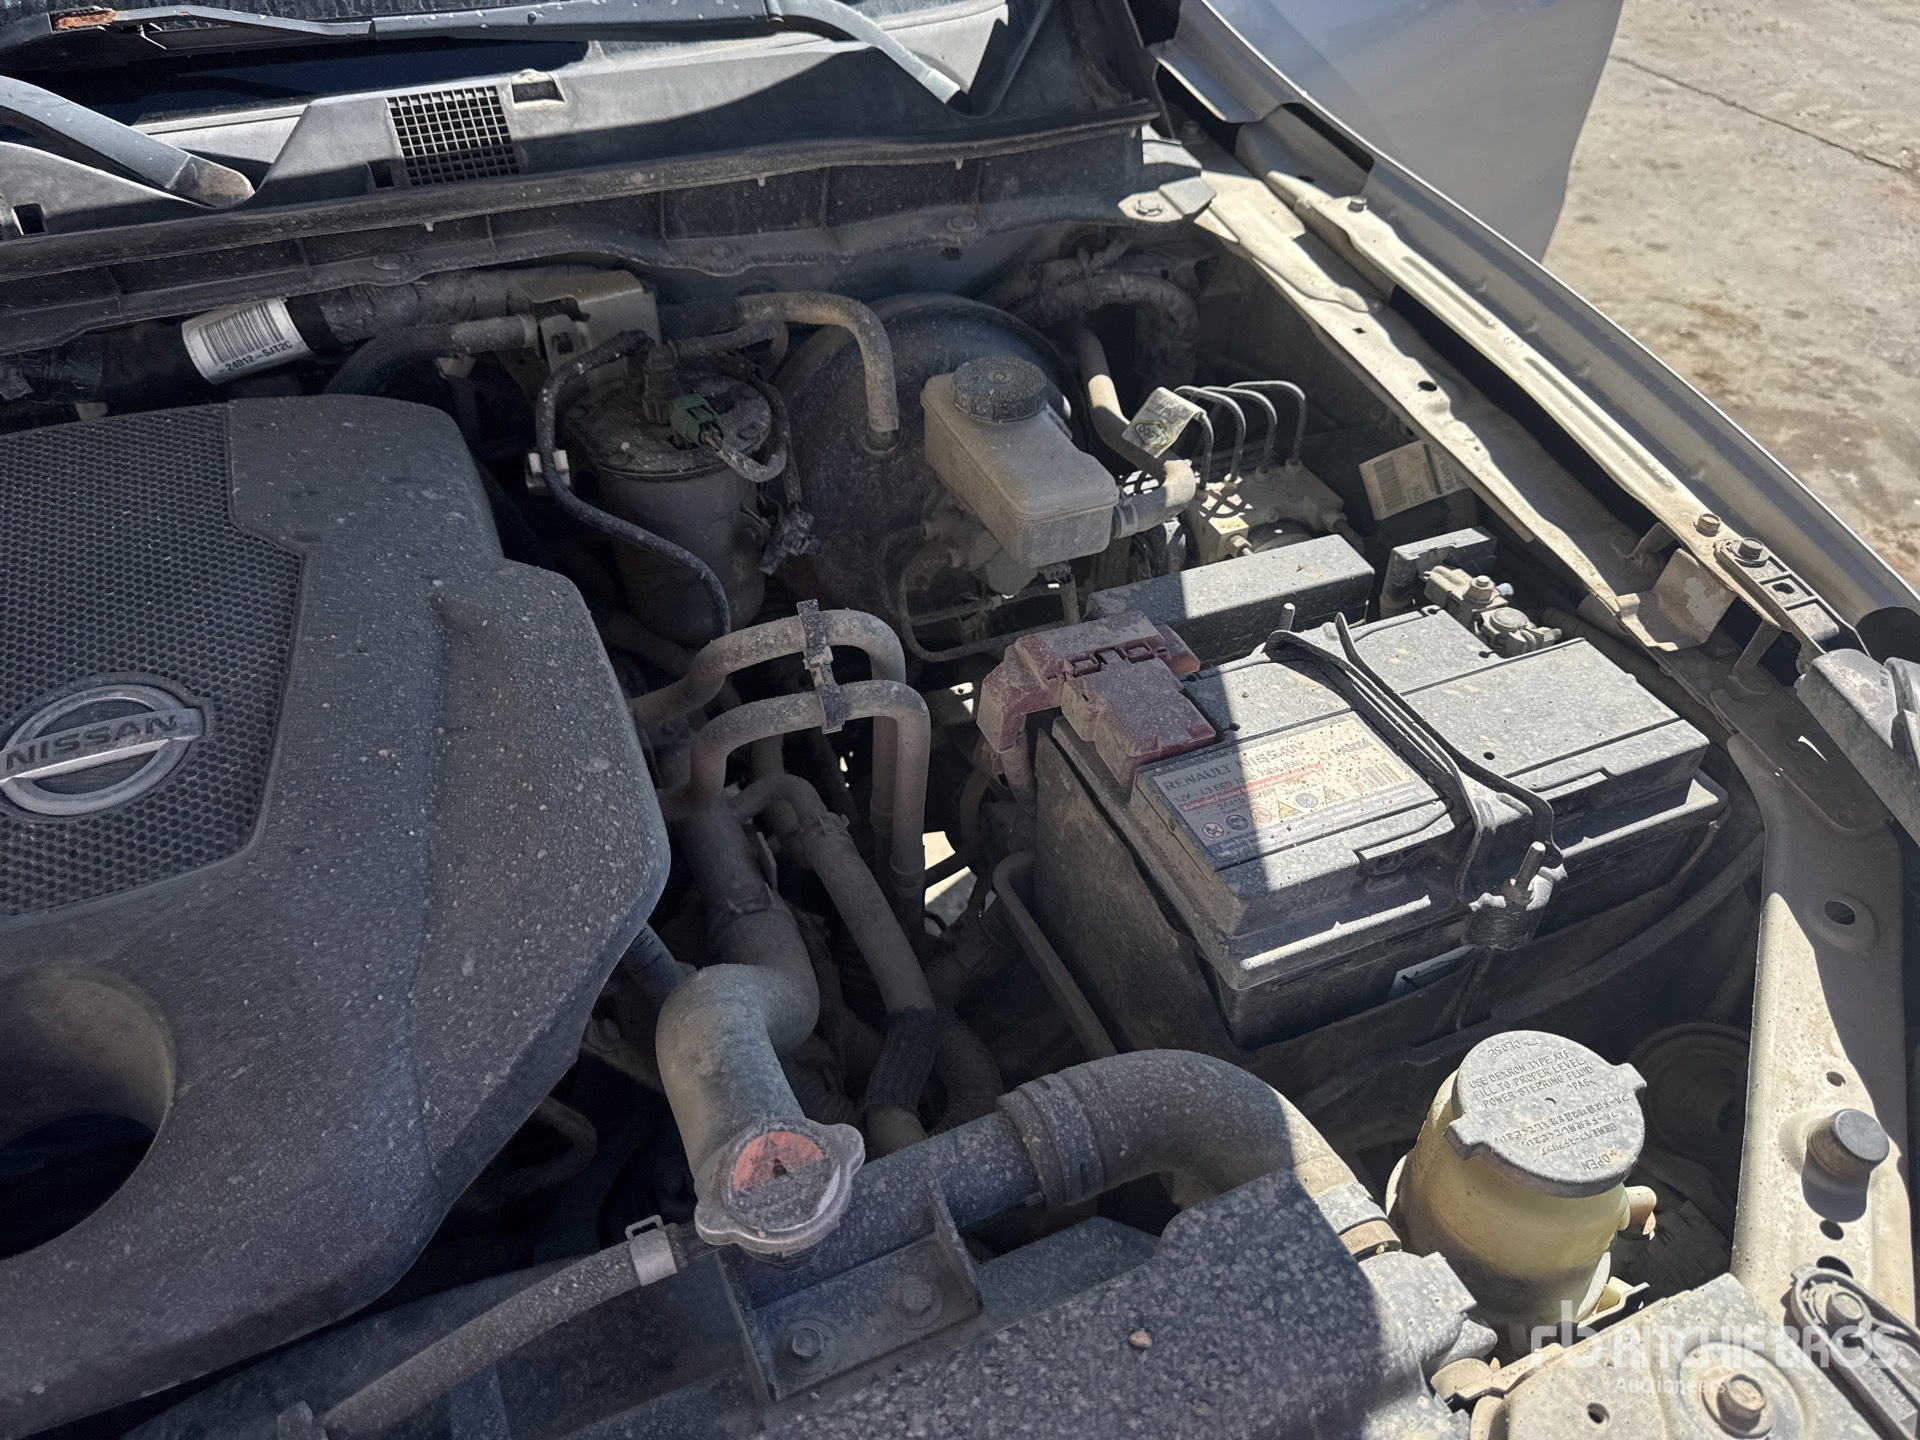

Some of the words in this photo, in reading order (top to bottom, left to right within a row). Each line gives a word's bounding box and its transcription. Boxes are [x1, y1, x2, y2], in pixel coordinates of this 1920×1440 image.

[6, 714, 177, 770] NISSAN
[1162, 763, 1232, 792] RENAULT
[1235, 742, 1306, 770] NISSAN
[1488, 1039, 1521, 1059] CLOSE
[1468, 1078, 1489, 1089] USE
[1488, 1064, 1528, 1083] DEXRON
[1527, 1055, 1553, 1069] TYPE
[1473, 1086, 1498, 1100] FILL
[1497, 1080, 1511, 1091] TO
[1513, 1067, 1551, 1086] PROPER
[1481, 1091, 1517, 1109] POWER
[1517, 1075, 1565, 1097] STEERING
[1565, 1066, 1594, 1081] FLUID
[1581, 1153, 1611, 1171] OPEN
